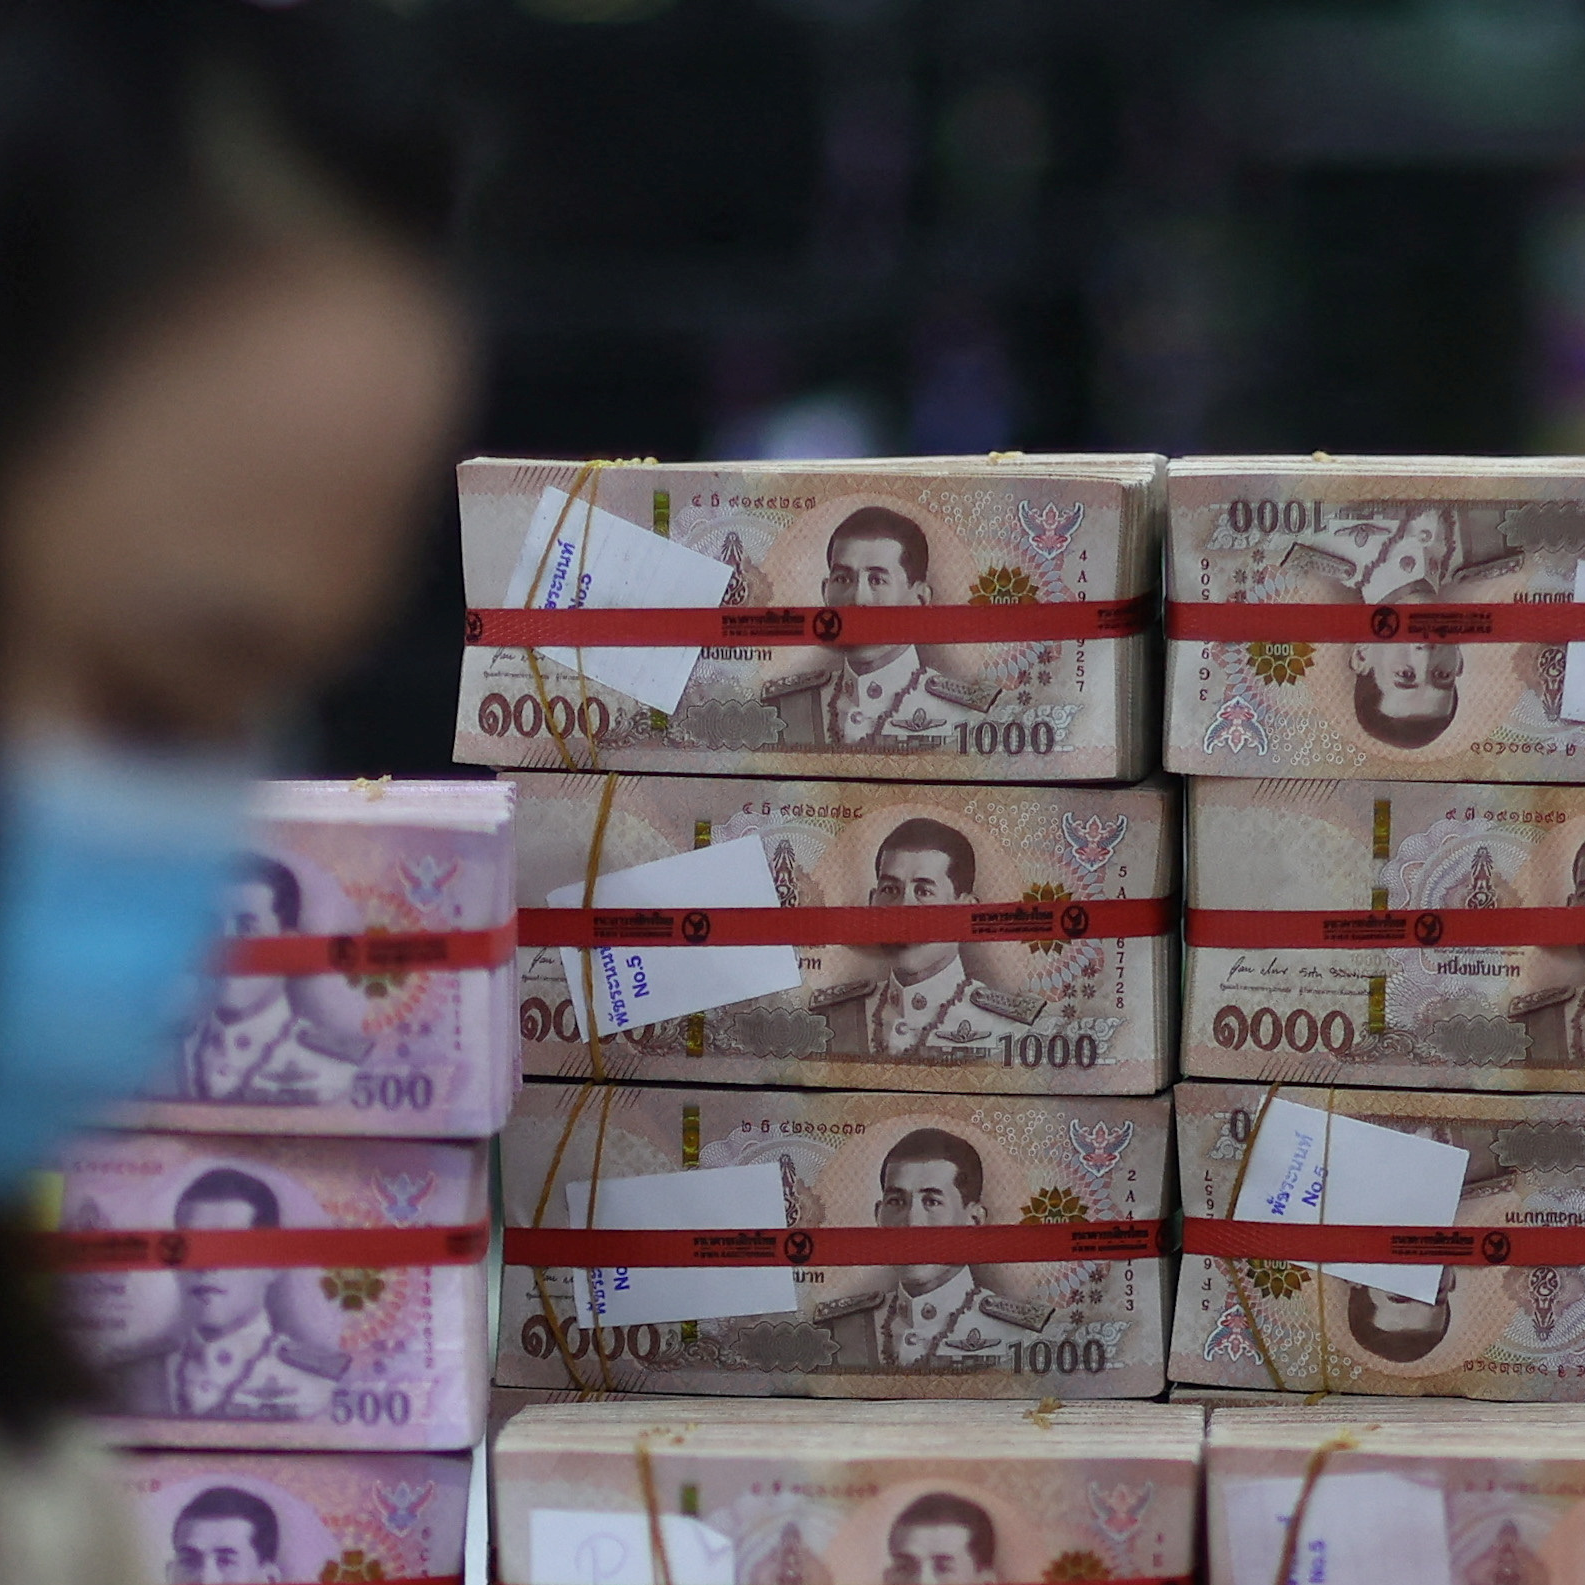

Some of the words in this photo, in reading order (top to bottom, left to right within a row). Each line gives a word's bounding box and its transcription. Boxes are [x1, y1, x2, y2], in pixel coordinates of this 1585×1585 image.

[1229, 500, 1327, 535] 1000
[478, 692, 610, 739] ๑๐๐๐
[954, 720, 1056, 756] 1000
[1117, 865, 1128, 879] 5
[625, 955, 650, 999] No.5
[1212, 1004, 1355, 1054] ๑๐๐๐
[997, 1033, 1099, 1070] 1000
[350, 1073, 434, 1112] 500
[1126, 1169, 1137, 1182] 2
[1124, 1190, 1136, 1203] A
[1007, 1339, 1106, 1375] 1000
[330, 1389, 412, 1427] 500
